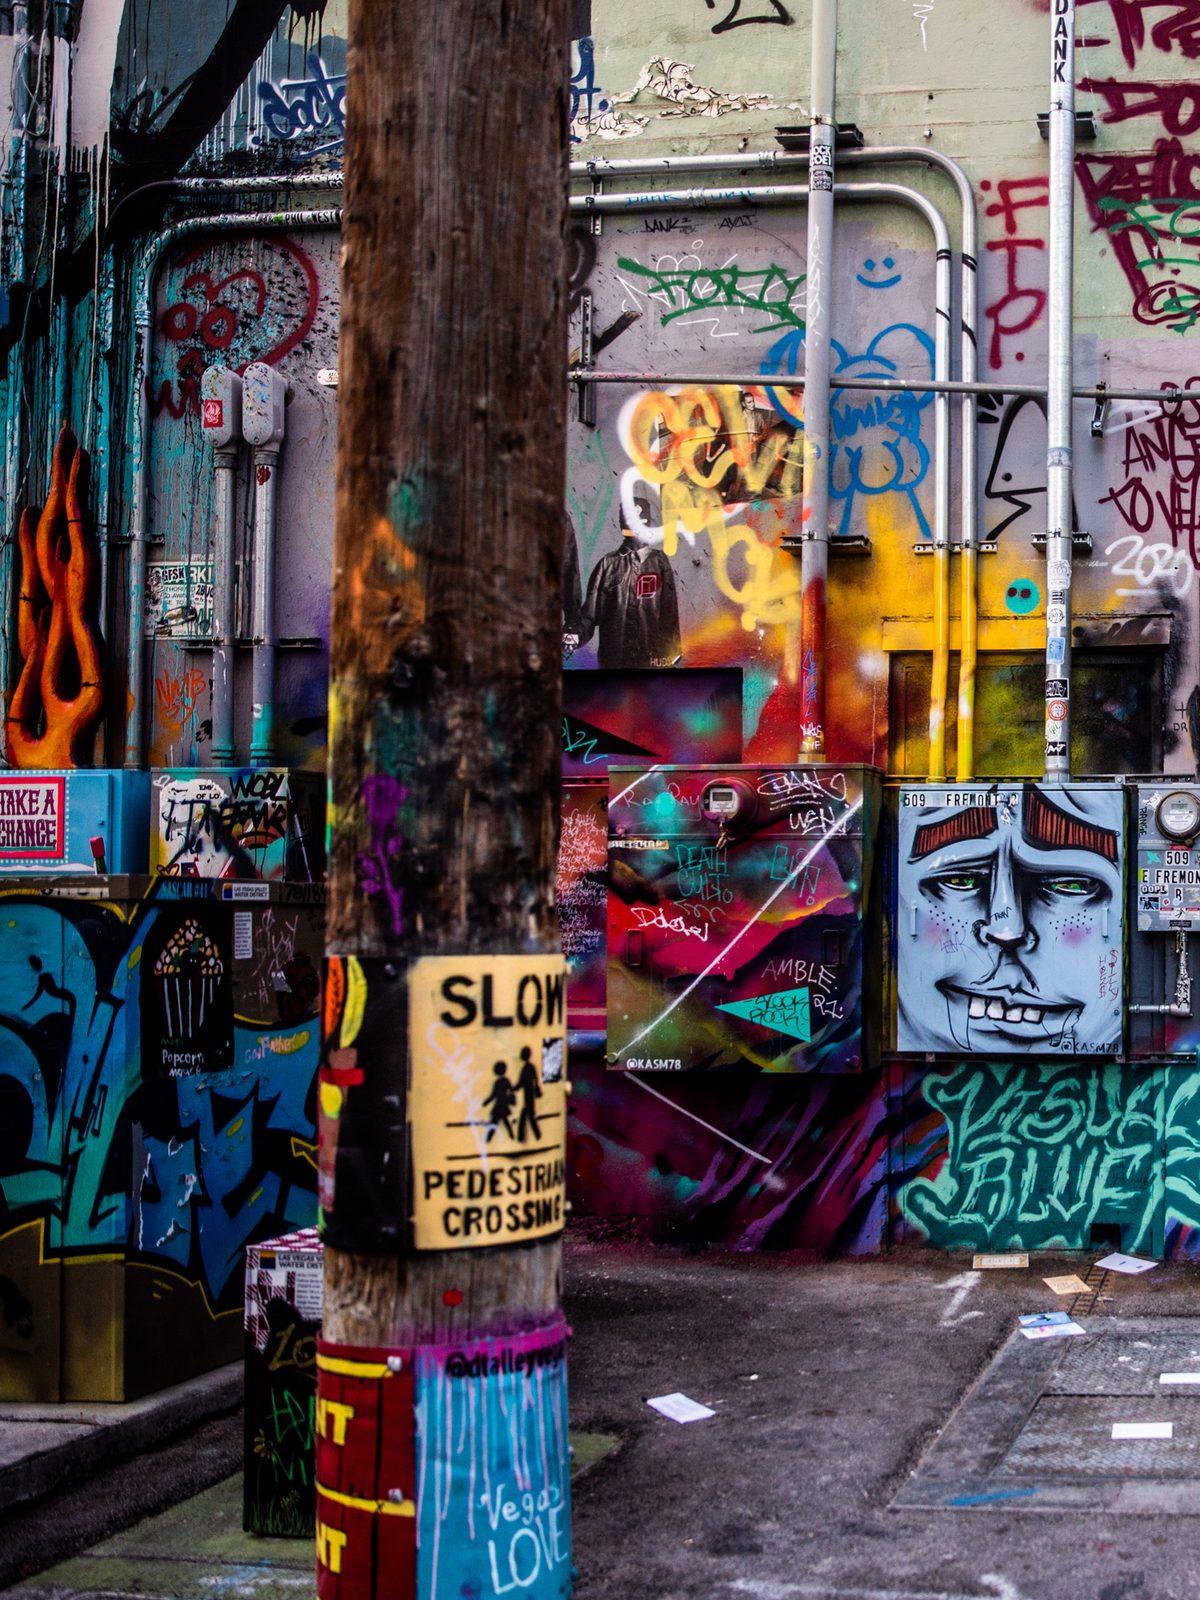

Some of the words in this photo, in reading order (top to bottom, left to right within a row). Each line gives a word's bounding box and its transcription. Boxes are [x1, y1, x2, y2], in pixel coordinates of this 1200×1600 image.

[0, 789, 40, 815] TAKE
[42, 789, 56, 815] A
[0, 819, 57, 848] CHANGE
[1166, 851, 1190, 865] 509
[1142, 869, 1149, 883] E
[440, 973, 563, 1027] SLOW
[626, 1058, 682, 1070] @KASM78
[292, 1253, 314, 1261] VEGAS
[279, 1261, 305, 1269] WATER
[488, 1504, 568, 1595] LOVE
